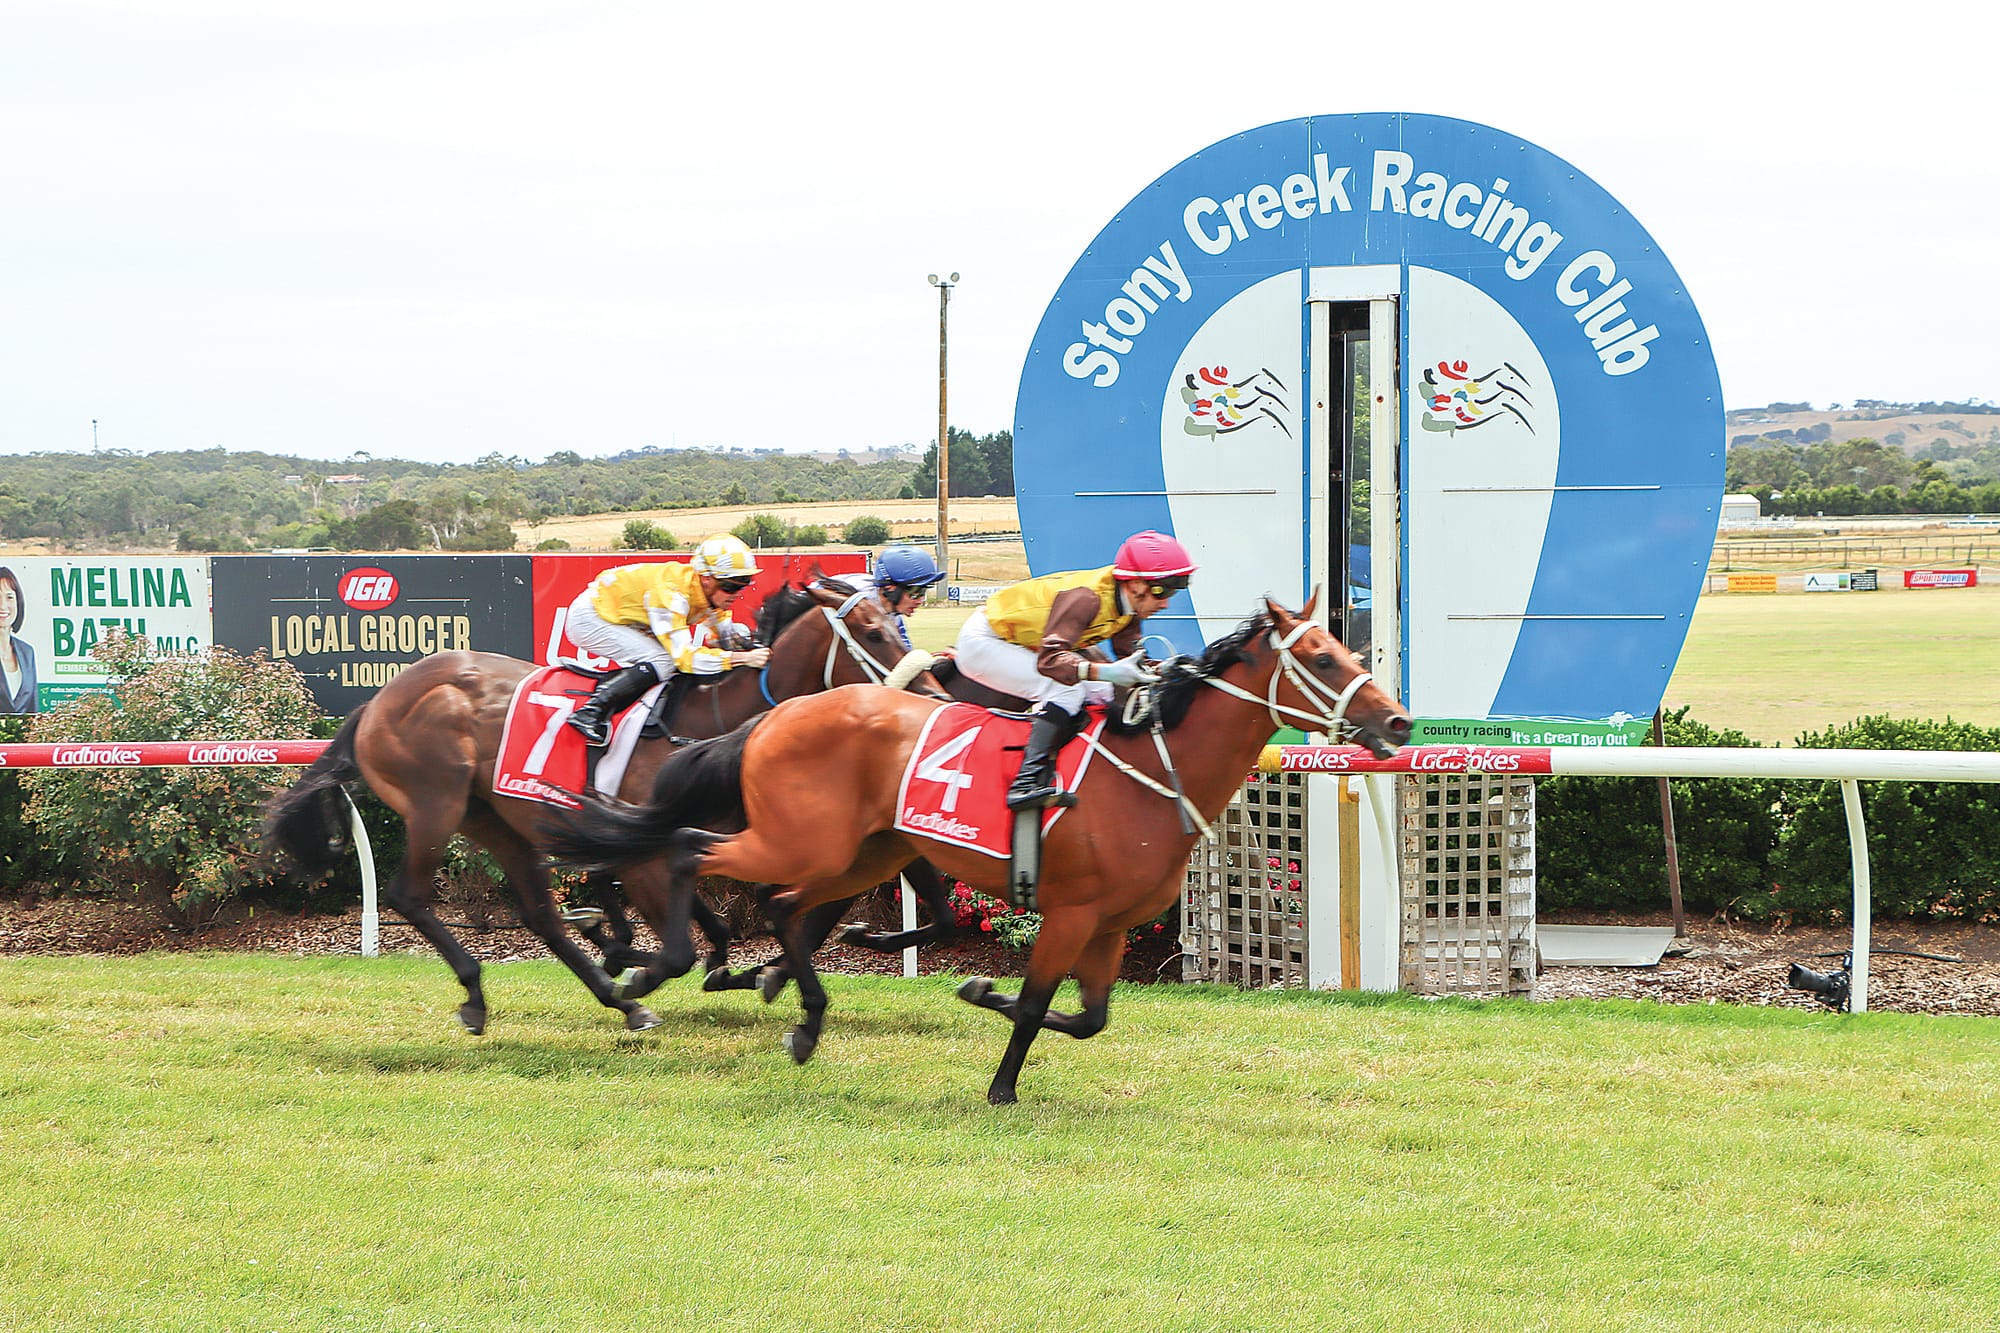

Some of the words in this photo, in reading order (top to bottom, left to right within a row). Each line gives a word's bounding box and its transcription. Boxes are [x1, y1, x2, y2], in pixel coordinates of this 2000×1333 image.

[1063, 239, 1194, 387] Stony
[1183, 152, 1353, 256] Creek
[1369, 149, 1564, 281] Racing
[1555, 249, 1660, 376] Club
[50, 567, 192, 608] MELINA
[271, 615, 355, 659] LOCAL
[360, 614, 471, 655] GROCER
[341, 662, 411, 688] LIQUO
[522, 691, 576, 775] 7
[1423, 725, 1469, 738] country
[1473, 725, 1511, 739] racing
[1511, 730, 1530, 744] It's
[1533, 733, 1540, 744] a
[1606, 733, 1628, 746] Out
[52, 746, 142, 766] Ladbrokes
[188, 744, 278, 764] Ladbrokes
[915, 726, 983, 812] 4
[1280, 748, 1354, 769] brokes
[1410, 748, 1521, 771] Ladbokes
[498, 773, 580, 806] Ladbro
